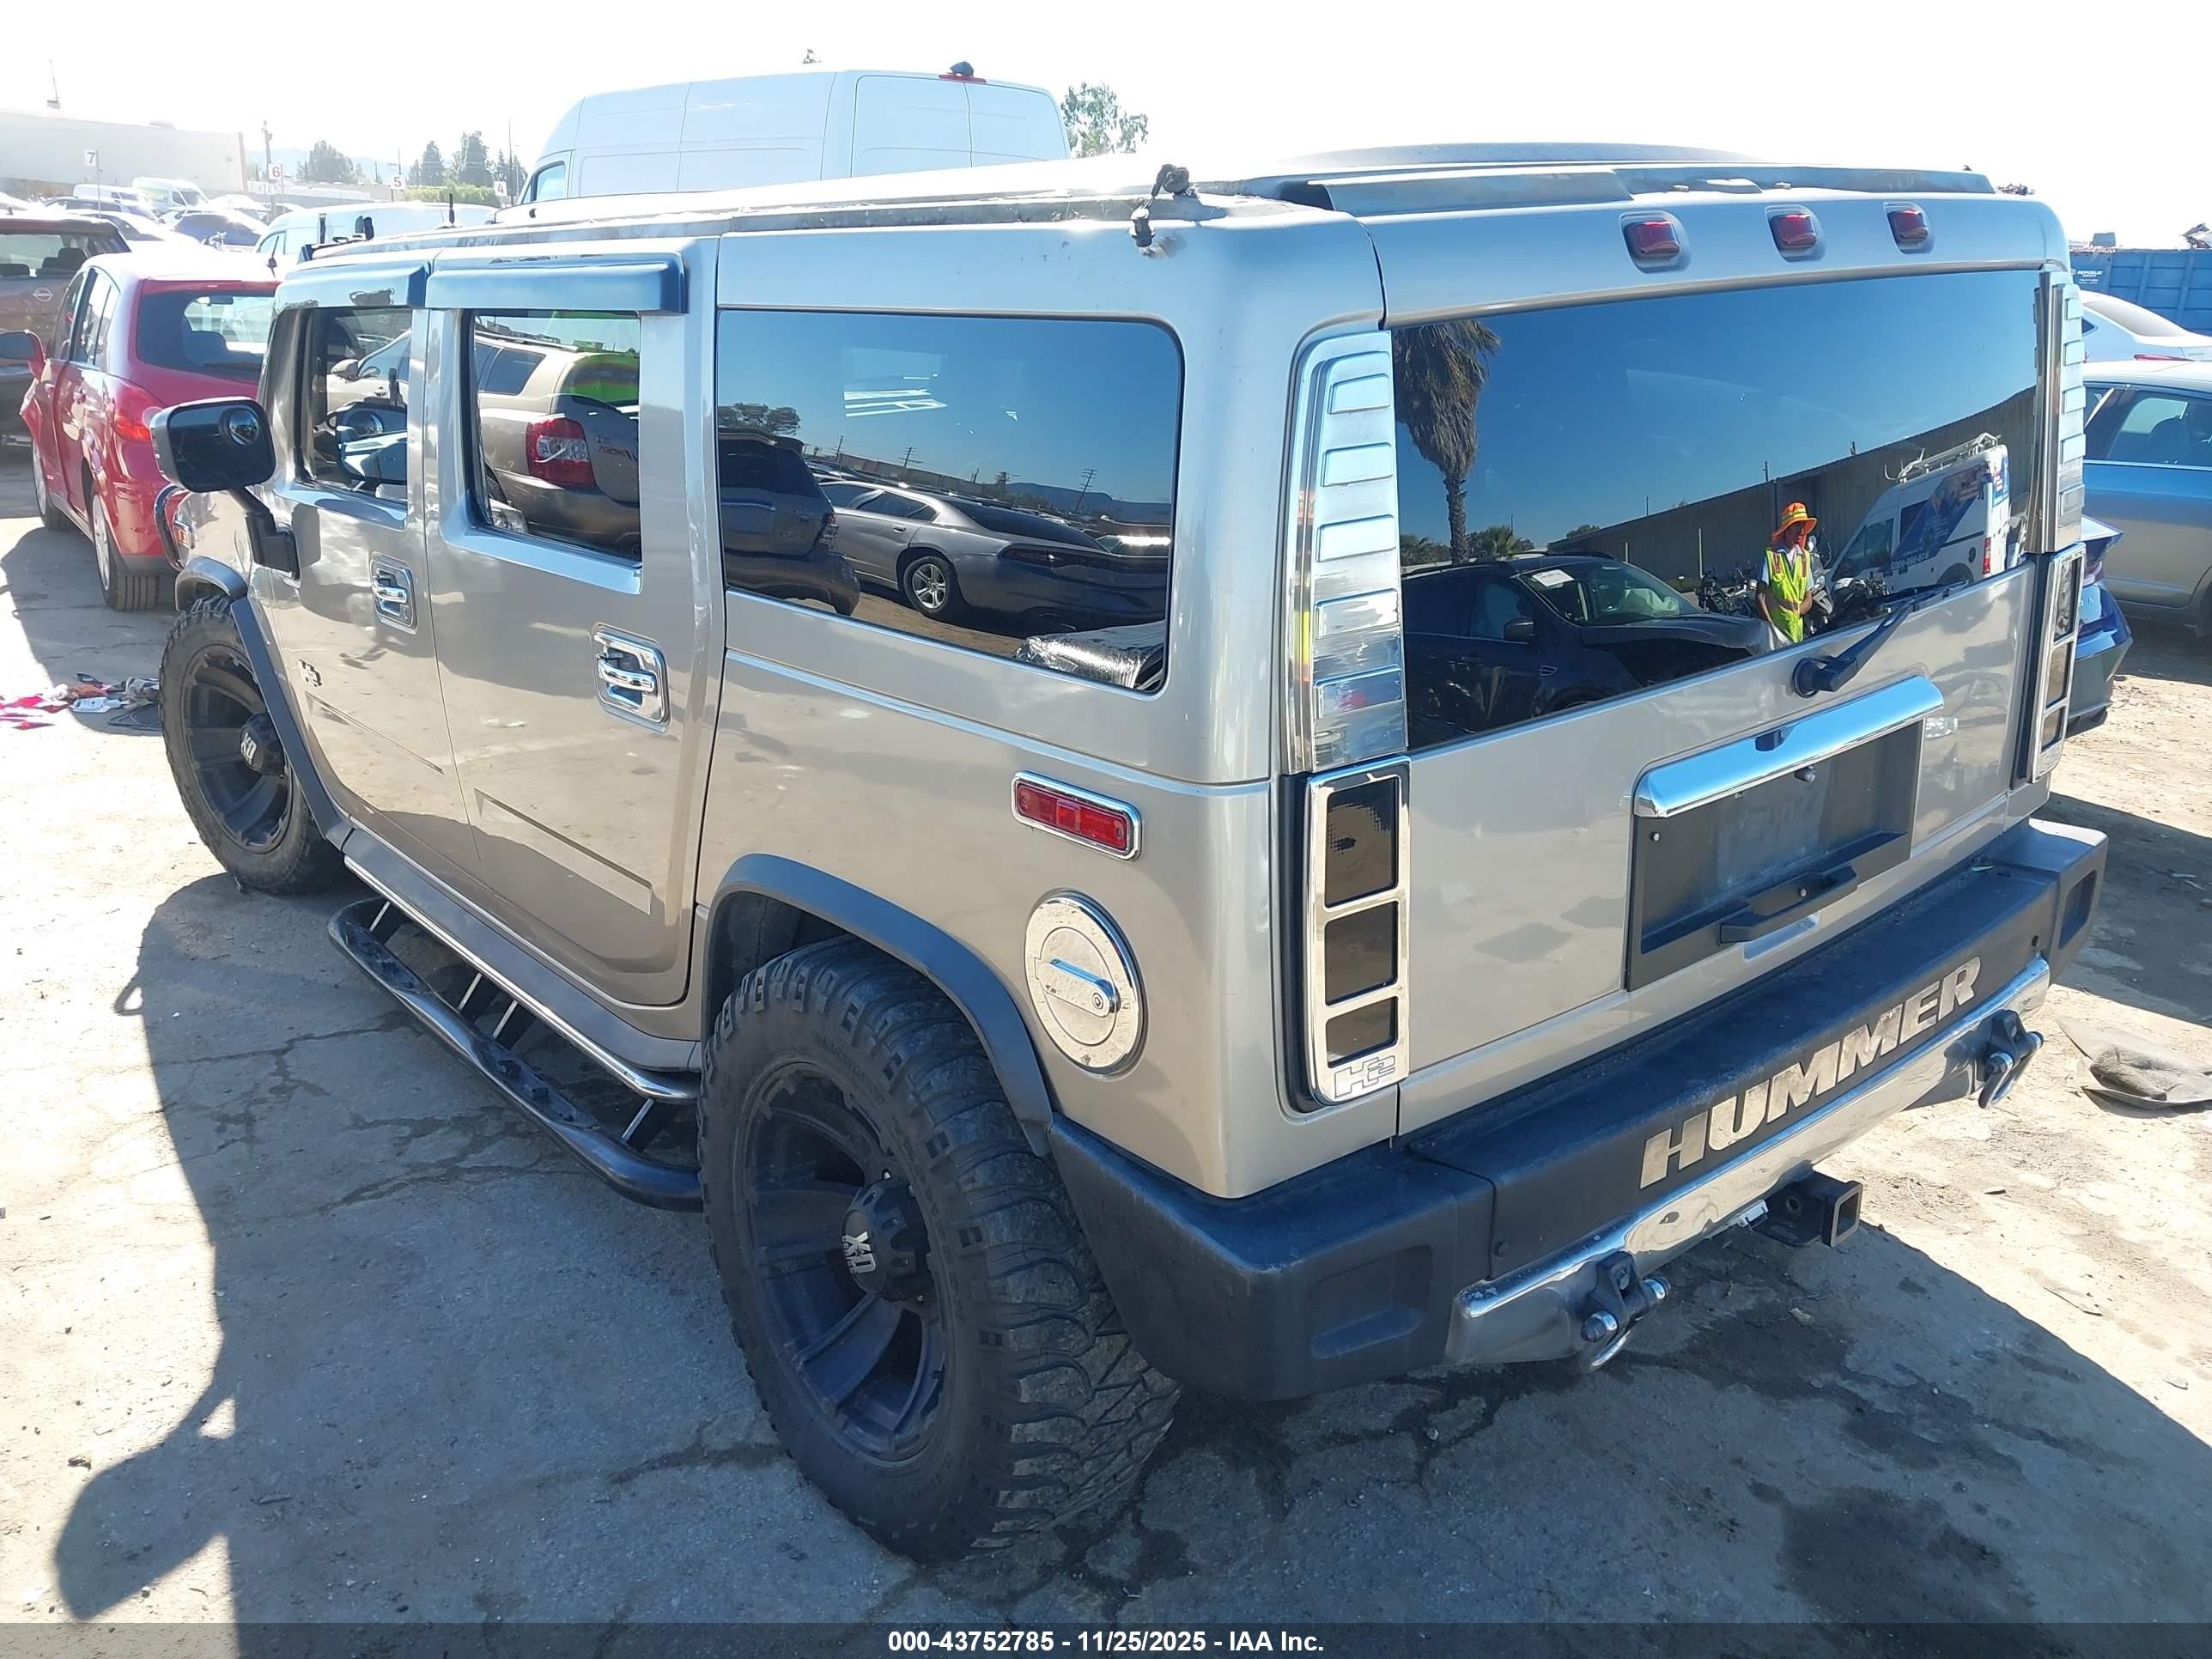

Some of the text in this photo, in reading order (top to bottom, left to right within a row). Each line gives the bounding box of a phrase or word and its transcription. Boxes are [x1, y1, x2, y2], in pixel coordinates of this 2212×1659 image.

[87, 151, 96, 164] 7
[272, 166, 281, 178] 6
[393, 176, 402, 187] 5
[496, 183, 505, 194] 4
[1334, 1054, 1396, 1100] H2
[1639, 956, 1982, 1190] HUMMER
[844, 1231, 877, 1273] XD
